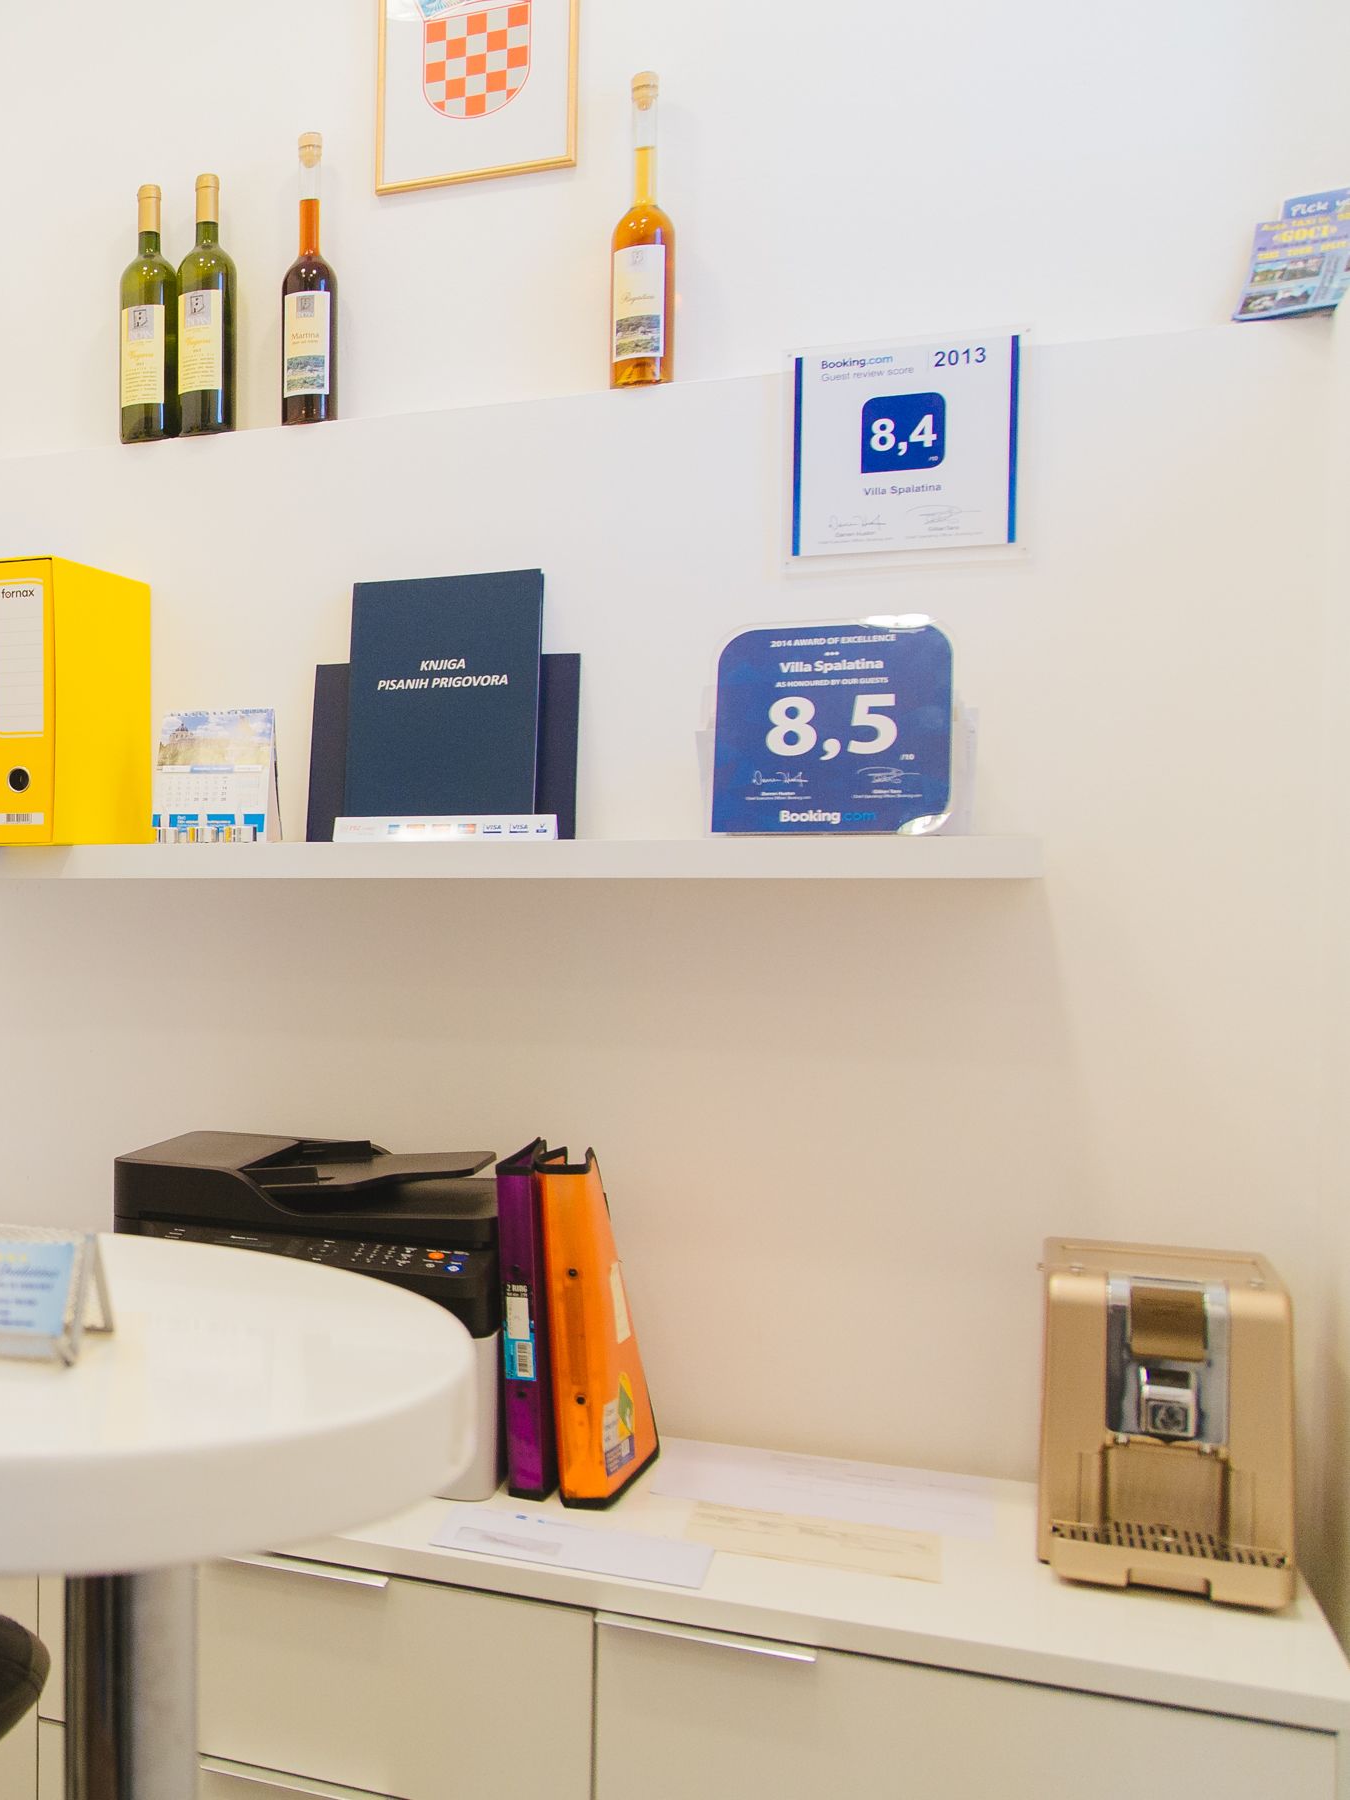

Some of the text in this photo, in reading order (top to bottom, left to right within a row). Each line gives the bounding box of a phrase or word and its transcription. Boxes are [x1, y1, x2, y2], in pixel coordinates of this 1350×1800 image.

[1291, 201, 1329, 217] Pick
[291, 332, 320, 340] Martina
[821, 346, 987, 369] Booking.com 2013
[821, 366, 914, 382] Guest review score
[869, 413, 938, 456] 8,4
[863, 483, 943, 496] Villa Spalatina
[1, 587, 35, 600] fornax
[770, 634, 897, 648] 2014 AWARD OF EXCELLENCE
[420, 658, 466, 671] KNJIGA
[779, 658, 884, 674] Villa Spalatina
[377, 674, 509, 691] PISANIH PRIGOVORA
[859, 676, 889, 684] GUESTS
[765, 693, 898, 761] 8,5
[779, 809, 876, 824] Booking.com
